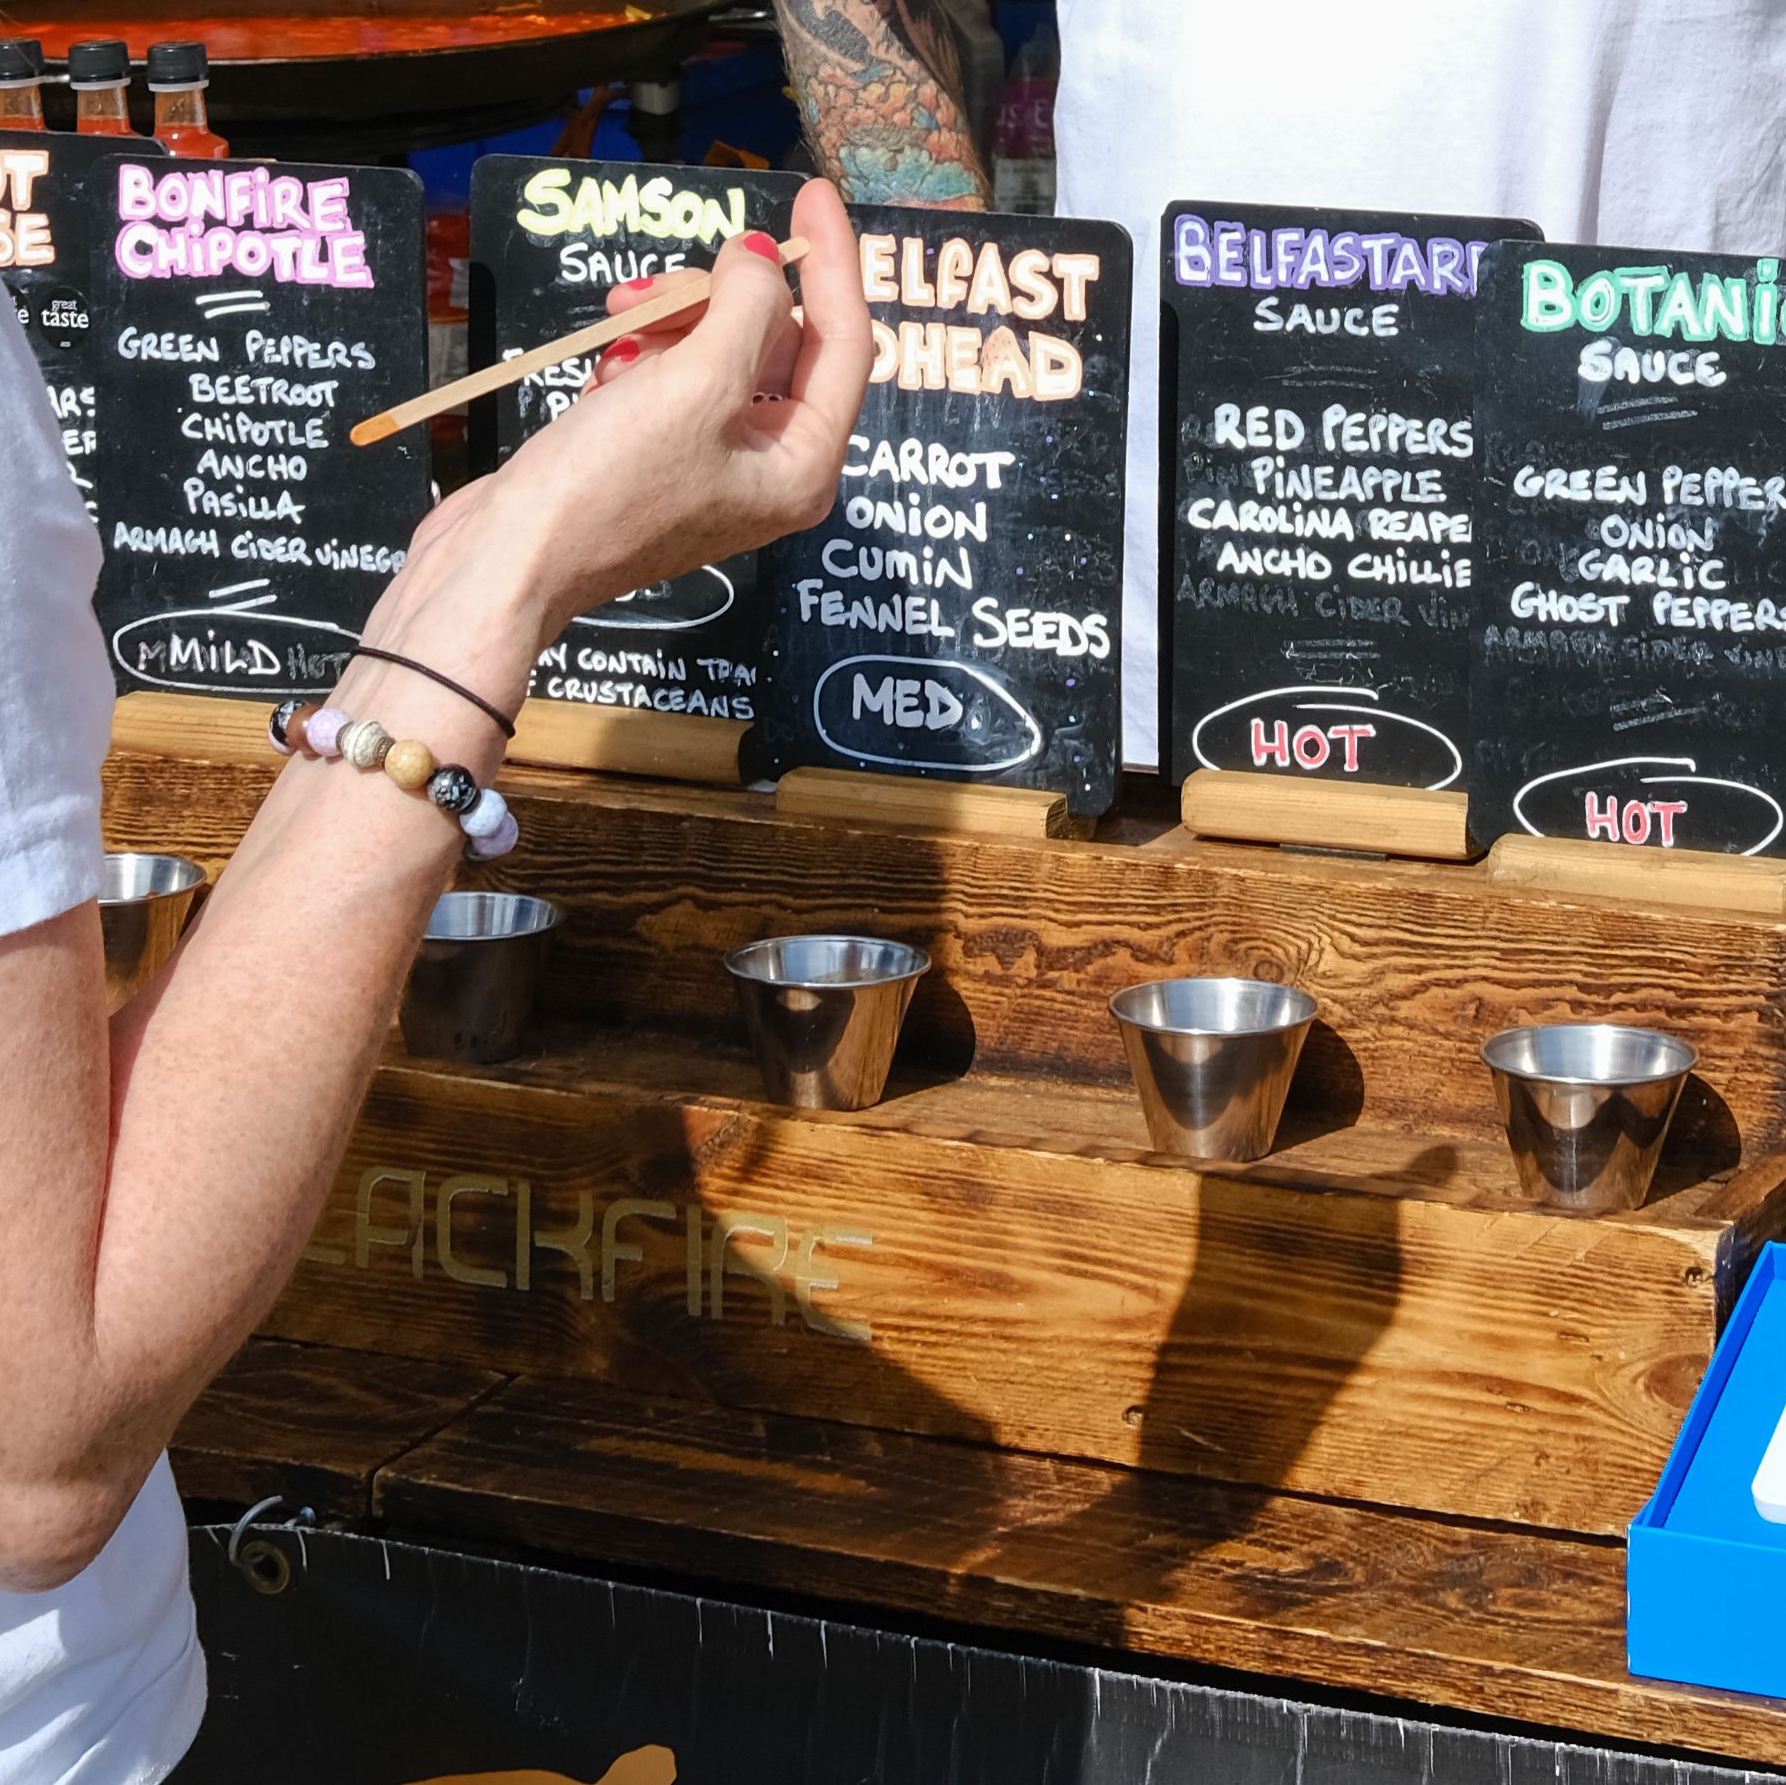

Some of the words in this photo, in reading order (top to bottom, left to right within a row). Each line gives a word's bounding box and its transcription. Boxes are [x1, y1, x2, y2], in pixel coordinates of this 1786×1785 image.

[517, 170, 746, 245] SAMSON
[860, 233, 1100, 322] ELFAST
[41, 308, 89, 329] taste
[1253, 296, 1399, 337] SAUCE
[117, 327, 221, 362] GREEN
[245, 330, 377, 370] PEPPERS
[870, 322, 1084, 401] DHEAD
[1577, 342, 1728, 387] SAUCE
[191, 374, 339, 408] BEETROOT
[1214, 403, 1306, 449] RED
[1321, 404, 1474, 457] PEPPERS
[196, 454, 308, 483] ANCHO
[840, 436, 1017, 490] CARROT
[1513, 465, 1647, 504] GREEN
[1369, 506, 1473, 545] REAPE
[1217, 546, 1333, 580] ANCHO
[797, 579, 956, 638] FENNEL
[973, 595, 1110, 659] SEEDS
[1510, 581, 1630, 627] GHOST
[547, 677, 754, 720] CRUSTACEANS
[851, 672, 964, 727] MED
[1250, 719, 1375, 772] HOT
[1584, 791, 1688, 848] HOT
